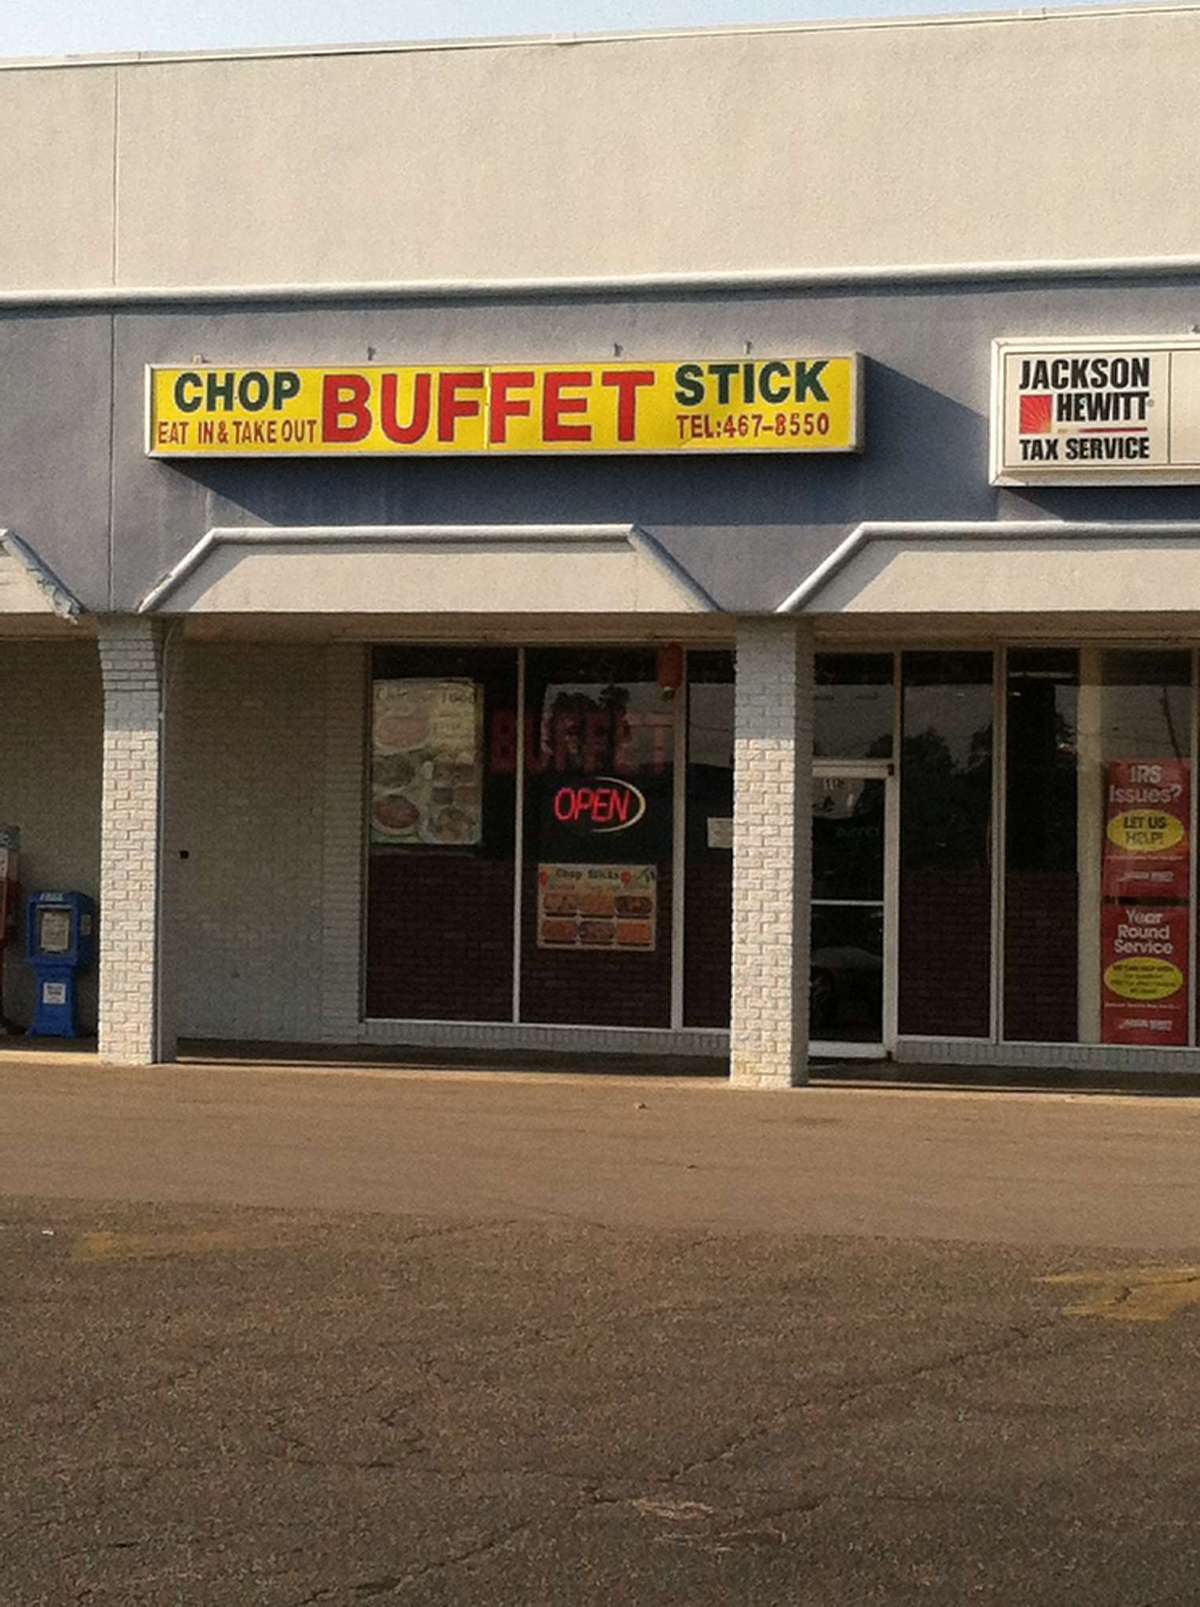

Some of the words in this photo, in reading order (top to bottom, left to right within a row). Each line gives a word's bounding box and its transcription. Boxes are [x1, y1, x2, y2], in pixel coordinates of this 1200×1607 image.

[674, 360, 830, 407] STICK
[1019, 357, 1151, 390] JACKSON
[174, 371, 301, 413] CHOP
[321, 371, 655, 444] BUFFET
[1056, 391, 1150, 422] HEWITT
[158, 420, 189, 444] EAT
[197, 420, 214, 444] IN
[217, 420, 229, 443] &
[232, 419, 277, 444] TAKE
[281, 419, 318, 444] OUT
[676, 412, 830, 439] TEL:467-8550
[1019, 439, 1059, 460] TAX
[1065, 436, 1150, 460] SERVICE
[1131, 764, 1162, 783] IRS
[554, 787, 631, 822] OPEN
[1109, 784, 1184, 804] Issues?
[1123, 816, 1145, 829] LET
[1147, 816, 1167, 829] US
[1126, 909, 1164, 924] Year
[1118, 924, 1171, 940] Round
[1114, 939, 1174, 954] Service
